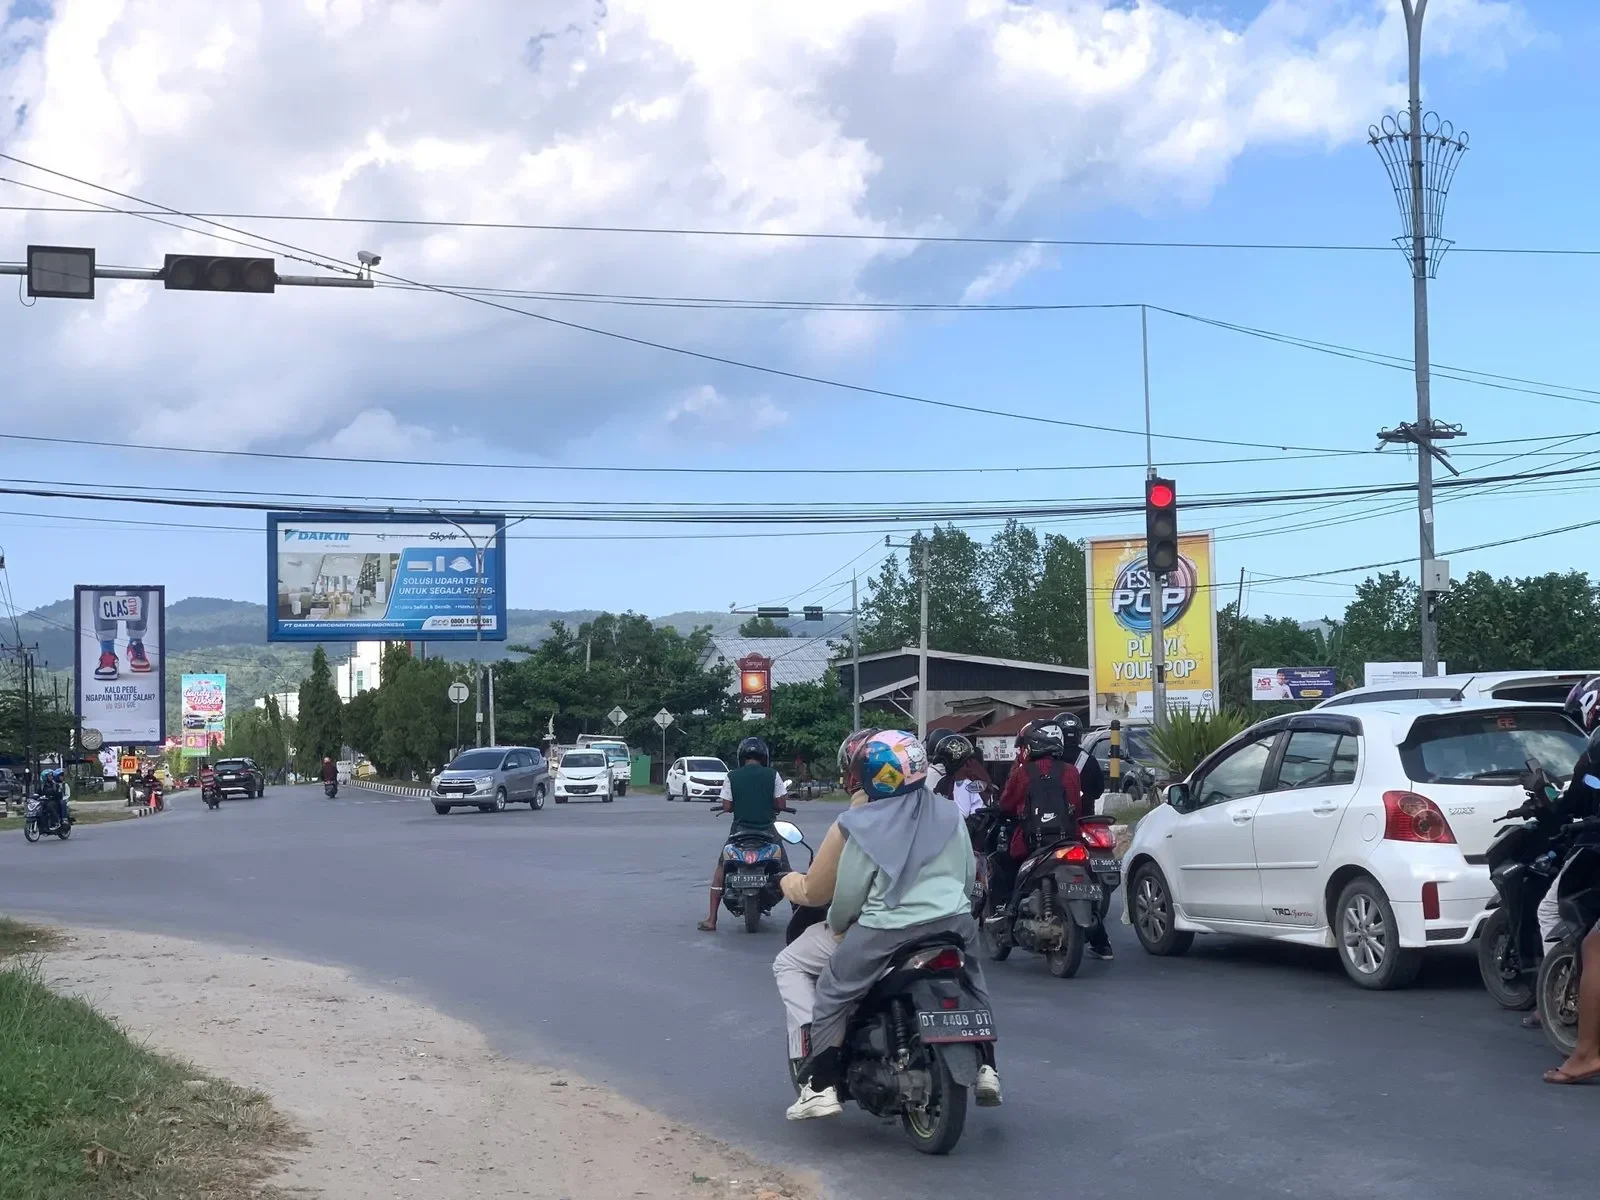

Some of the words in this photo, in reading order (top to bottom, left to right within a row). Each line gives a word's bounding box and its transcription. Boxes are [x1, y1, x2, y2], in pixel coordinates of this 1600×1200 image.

[298, 531, 349, 540] DAIKIN
[403, 577, 433, 585] SOLUSI
[435, 577, 464, 585] UDARA
[399, 587, 427, 595] UNTUK
[429, 587, 461, 595] SEGALA
[103, 600, 129, 618] CLAS
[1128, 639, 1179, 658] PLY!
[1164, 659, 1197, 678] POP
[105, 686, 121, 694] KALO
[122, 686, 138, 694] PEDE
[183, 687, 211, 700] Candy
[86, 694, 112, 702] NGAPAIN
[113, 694, 132, 702] TAKUT
[132, 693, 156, 701] SALAH?
[192, 694, 224, 705] World
[1272, 907, 1291, 916] TRD
[921, 1014, 935, 1027] DT
[943, 1014, 969, 1026] 4408
[975, 1012, 990, 1025] DT
